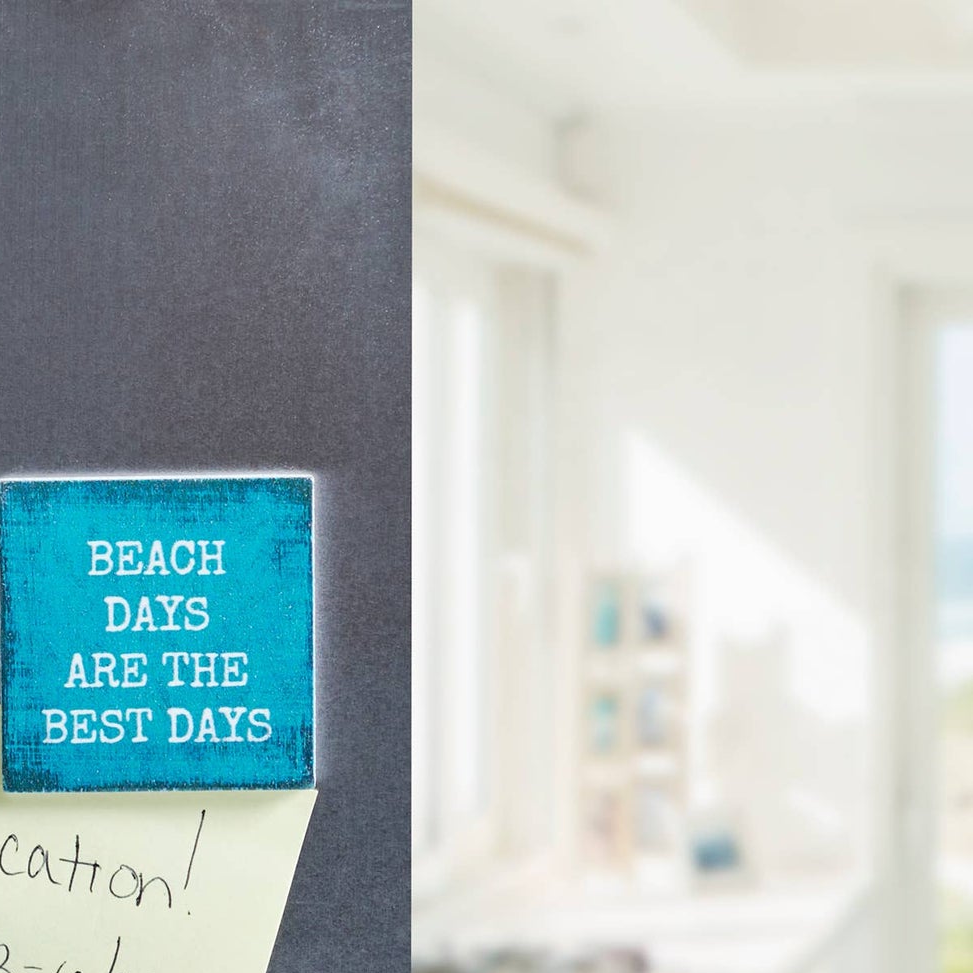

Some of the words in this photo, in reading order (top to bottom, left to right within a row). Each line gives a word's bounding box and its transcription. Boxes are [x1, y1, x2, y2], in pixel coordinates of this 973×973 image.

[87, 540, 226, 576] BEACH
[104, 595, 210, 633] DAYS
[63, 652, 148, 689] ARE
[162, 651, 249, 688] THE
[41, 708, 153, 745] BEST
[167, 706, 273, 743] DAYS
